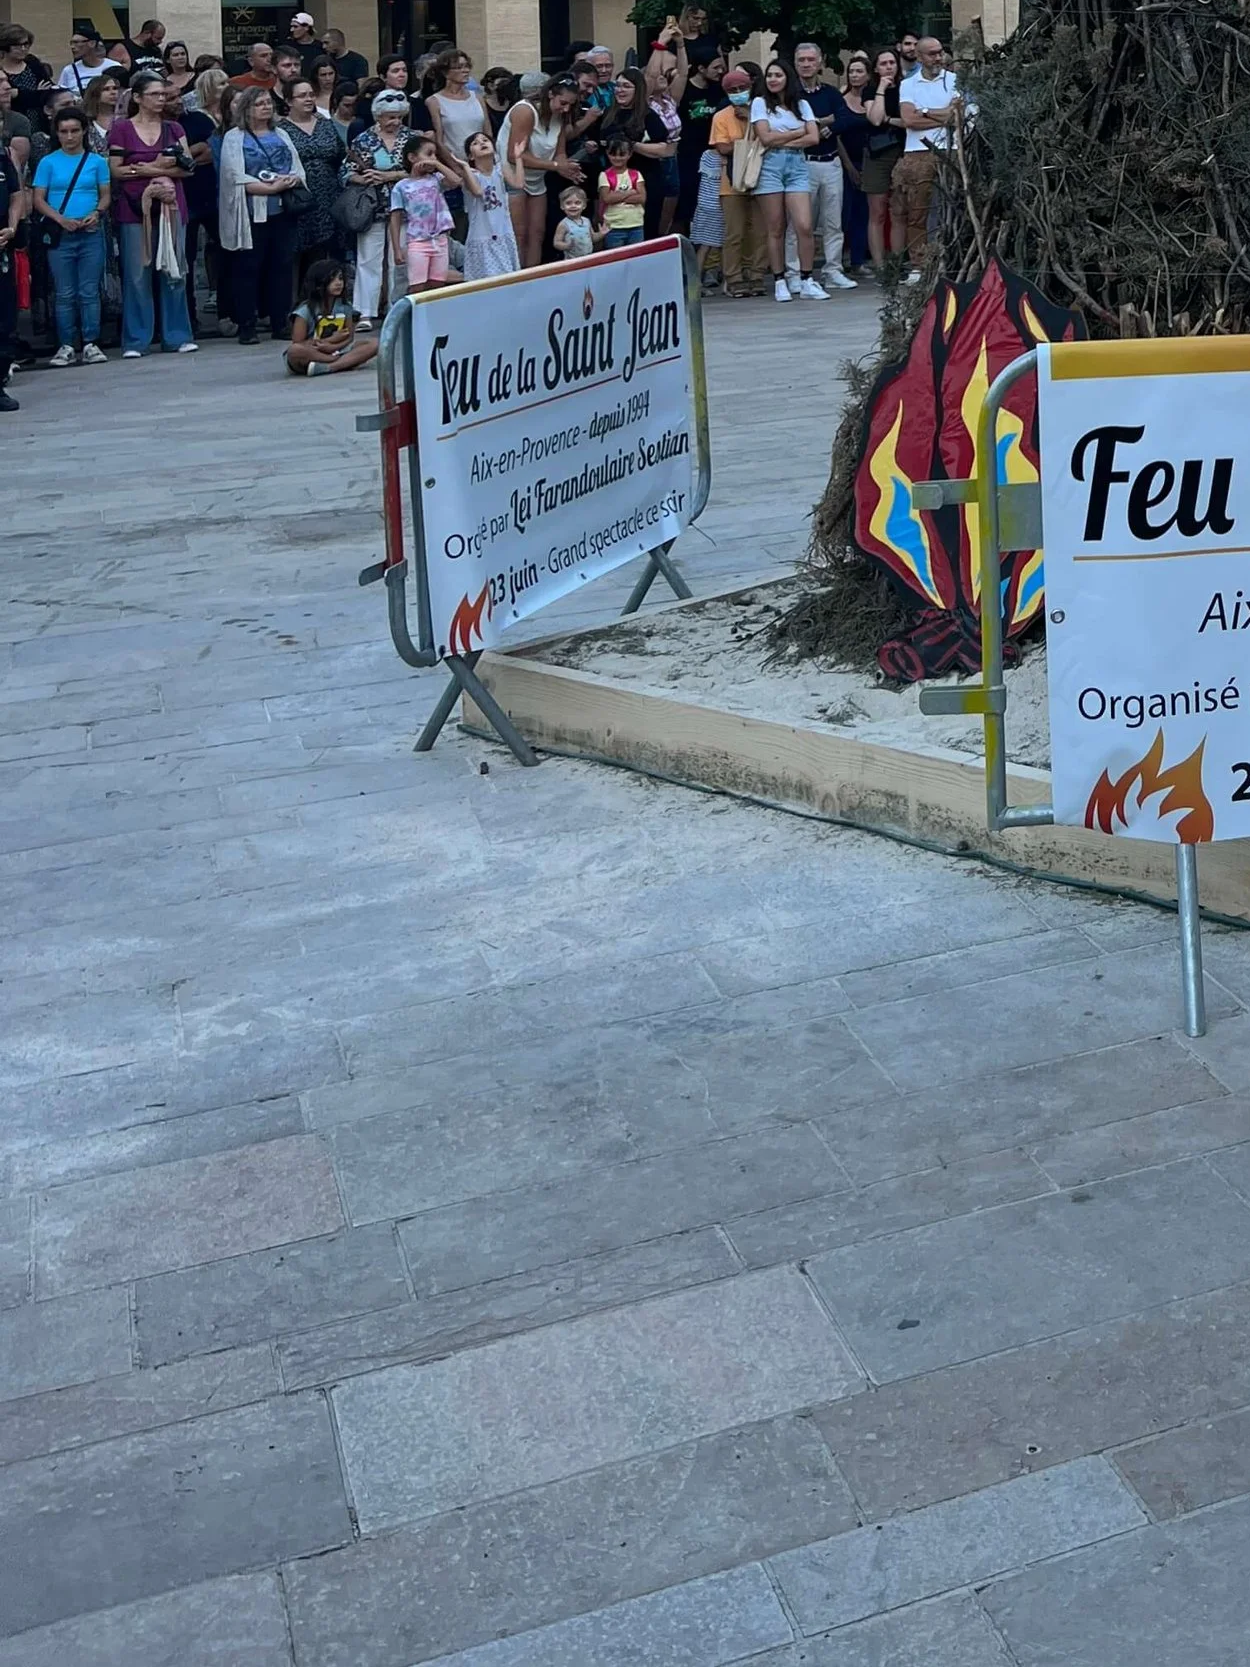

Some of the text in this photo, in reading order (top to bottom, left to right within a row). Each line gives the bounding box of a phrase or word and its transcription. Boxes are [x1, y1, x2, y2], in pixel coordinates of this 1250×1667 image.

[488, 352, 513, 404] de
[517, 347, 537, 397] la
[543, 298, 617, 391] Saint
[622, 287, 681, 383] Jean
[470, 427, 580, 486] Aix-en-Provence
[588, 402, 625, 444] depuis
[626, 388, 651, 427] 1994
[490, 512, 510, 544] par
[510, 486, 532, 535] Lei
[534, 447, 636, 517] Farandoulaire
[637, 429, 690, 472] Sestian
[1070, 424, 1235, 542] Feu
[510, 558, 539, 606] juin
[548, 539, 588, 575] Grand
[589, 508, 645, 555] spectacle
[646, 507, 660, 526] ce
[1078, 675, 1242, 730] Organisé
